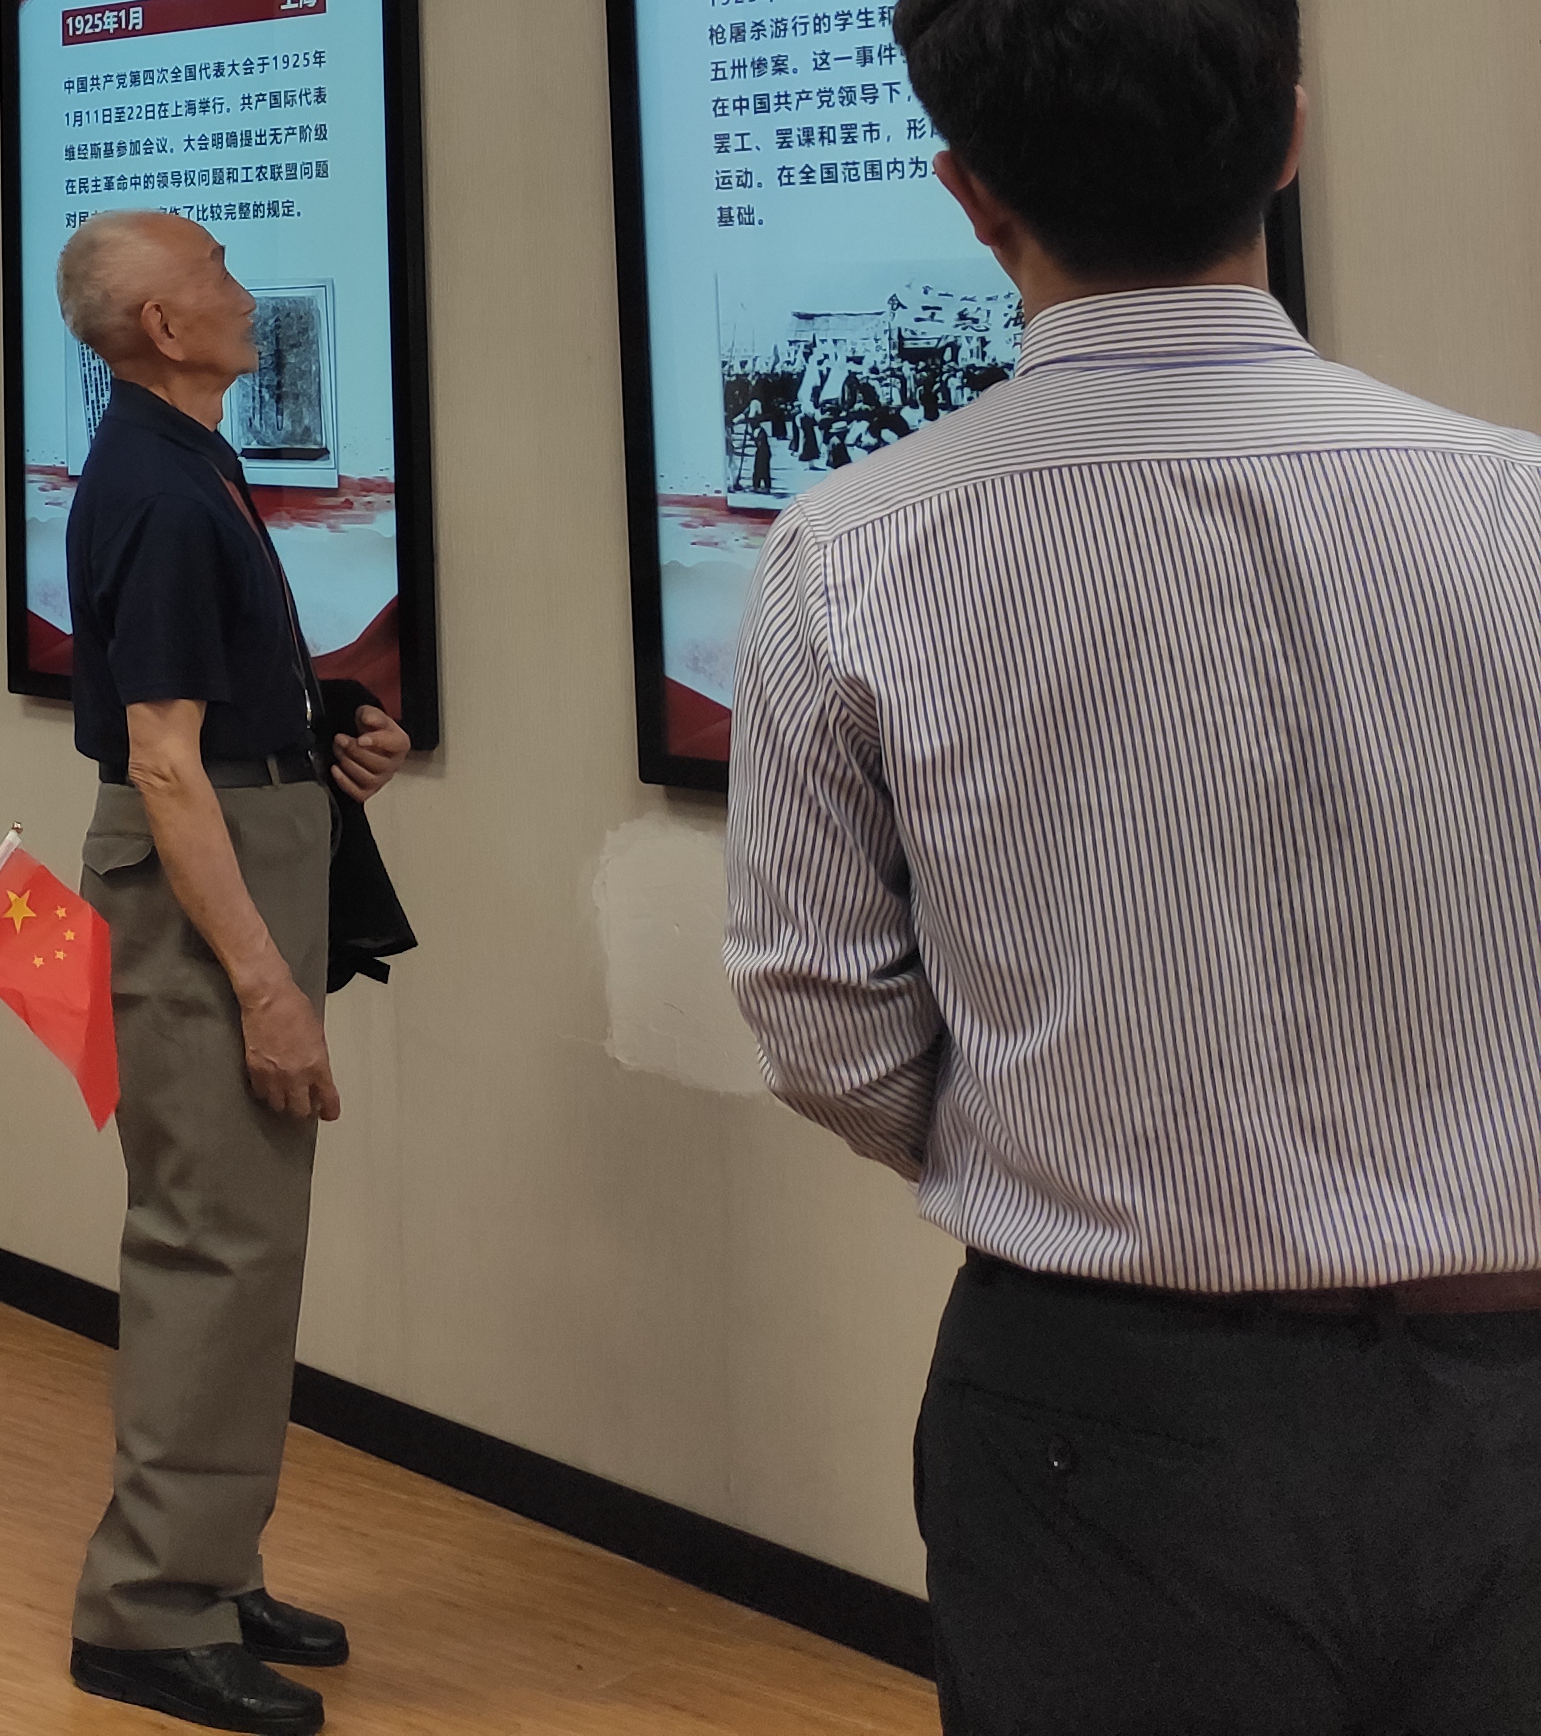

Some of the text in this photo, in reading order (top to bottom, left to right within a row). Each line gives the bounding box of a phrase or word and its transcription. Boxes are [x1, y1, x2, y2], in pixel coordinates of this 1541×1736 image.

[66, 6, 144, 37] 1925年1月
[63, 49, 327, 94] 中国共产党第四次全国代表大会于1925年
[709, 43, 908, 82] 五卅惨案。这一事件
[65, 86, 327, 127] 1月11日至22日在上海举行。共产国际代表
[711, 80, 913, 118] 在中国共产党领导下，
[65, 123, 328, 162] 维经斯基参加会议。大会明确提出无产阶级
[713, 116, 943, 155] 罢工、罢课和罢市，形
[65, 160, 329, 195] 在民主革命中的领导权问题和工农联盟问题
[714, 155, 936, 191] 运动。在全国范围内为
[717, 204, 765, 228] 基础。
